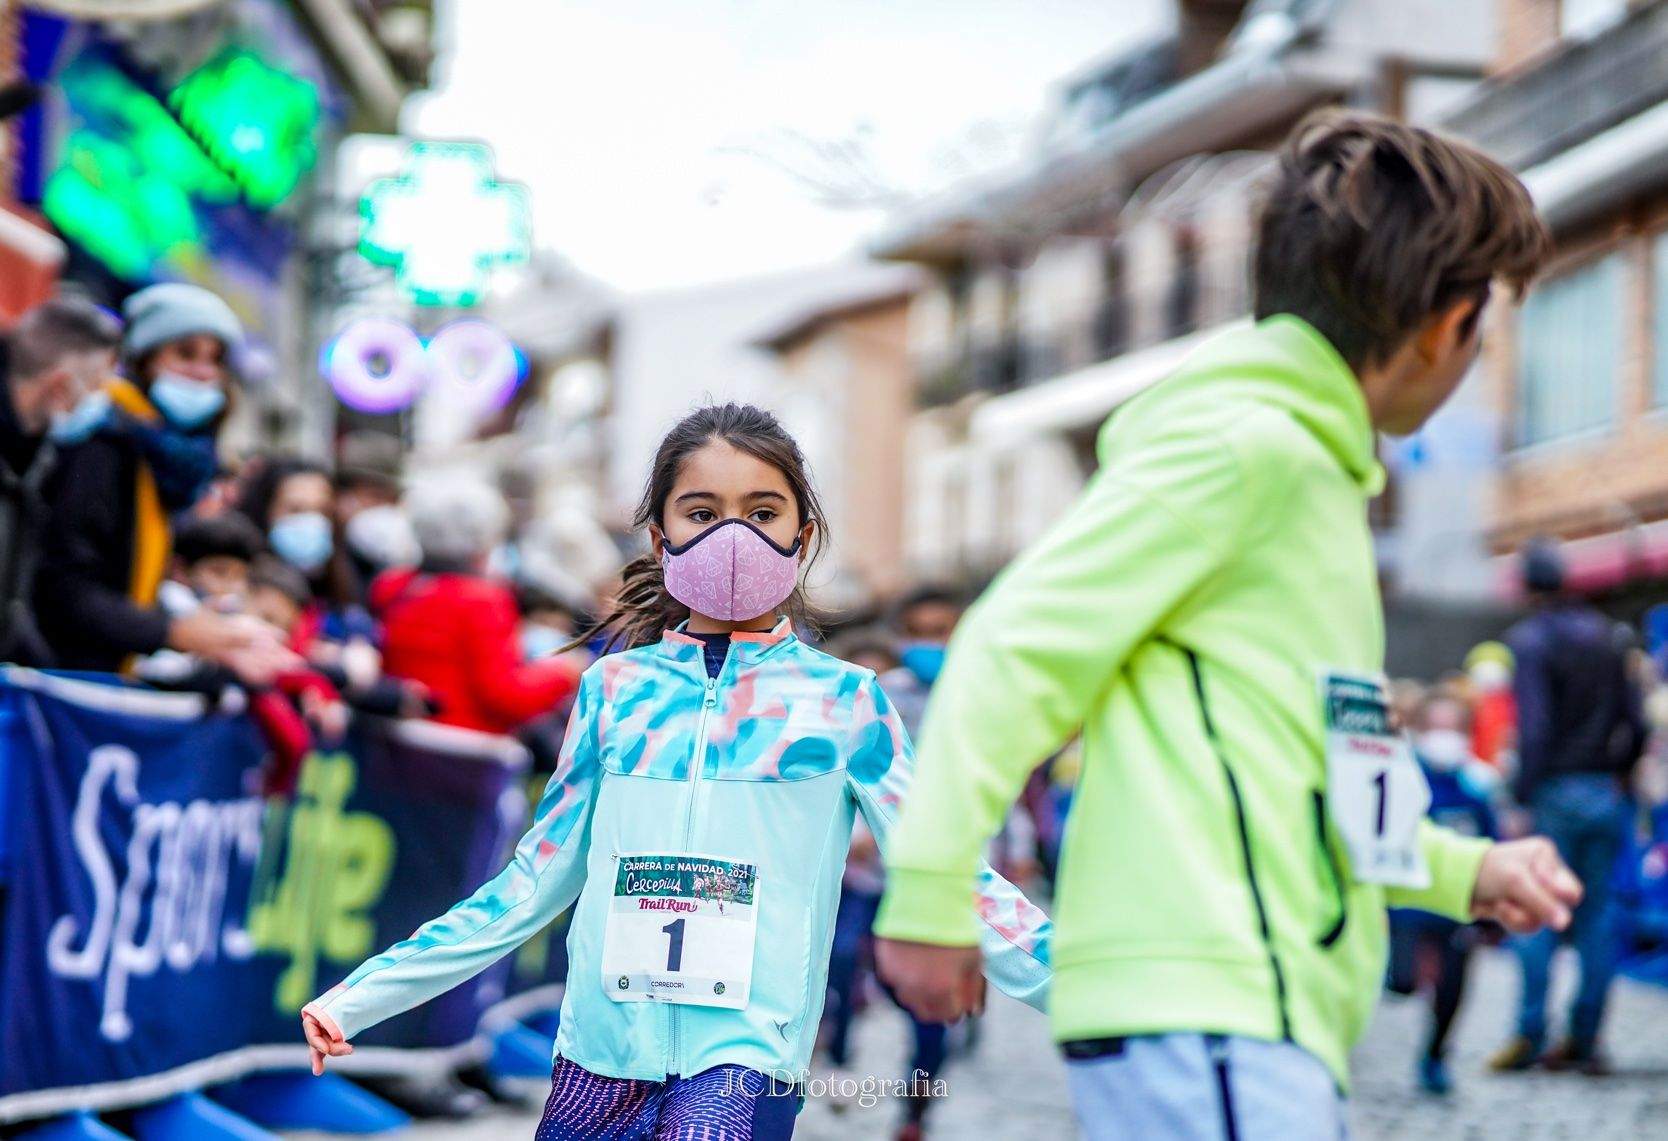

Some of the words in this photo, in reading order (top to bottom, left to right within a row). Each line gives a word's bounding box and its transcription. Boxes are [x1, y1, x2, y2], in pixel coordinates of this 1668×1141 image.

[1373, 771, 1387, 837] 1
[623, 861, 662, 872] CARRERA
[664, 863, 676, 871] DE
[677, 863, 724, 875] NAVIDAD
[728, 868, 748, 879] 2021
[662, 918, 686, 972] 1
